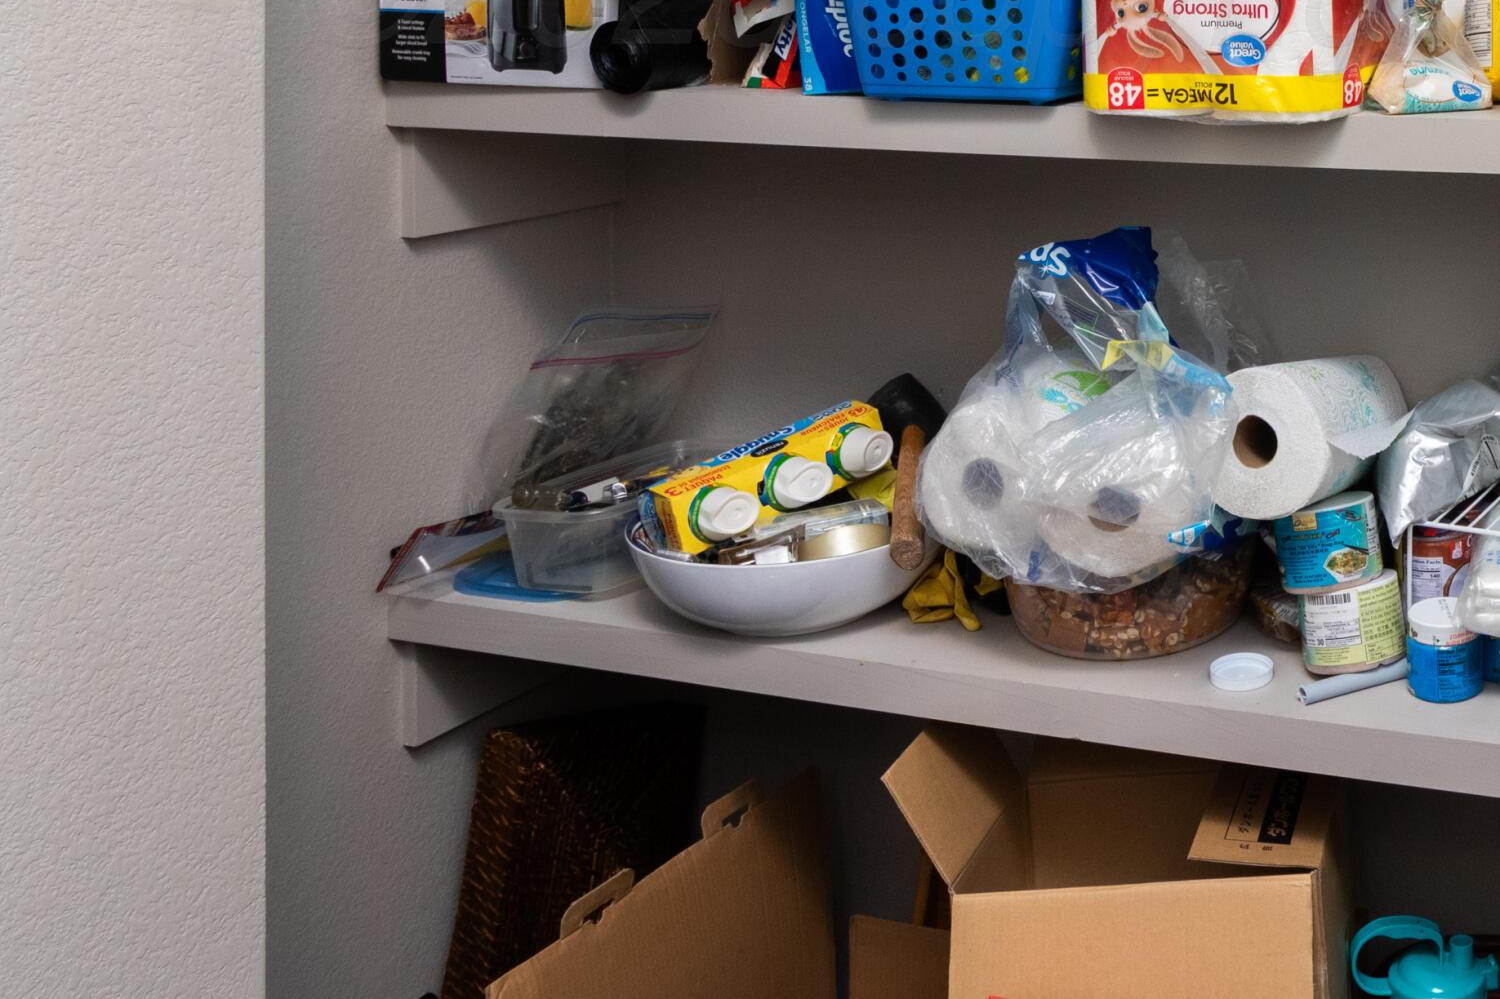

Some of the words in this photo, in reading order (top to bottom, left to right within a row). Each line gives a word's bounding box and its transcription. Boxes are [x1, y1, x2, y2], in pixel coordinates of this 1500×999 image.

[1172, 0, 1227, 18] Strong
[1231, 3, 1268, 19] Ultra
[1200, 20, 1243, 29] Premium
[1229, 40, 1253, 49] Value
[1229, 48, 1261, 59] Great
[1109, 81, 1142, 106] 48
[1162, 88, 1212, 103] MEGA
[1214, 82, 1238, 105] 12
[1344, 79, 1362, 102] 48
[719, 424, 794, 462] Snuggle
[664, 485, 681, 497] 3
[684, 474, 723, 492] PAQUET
